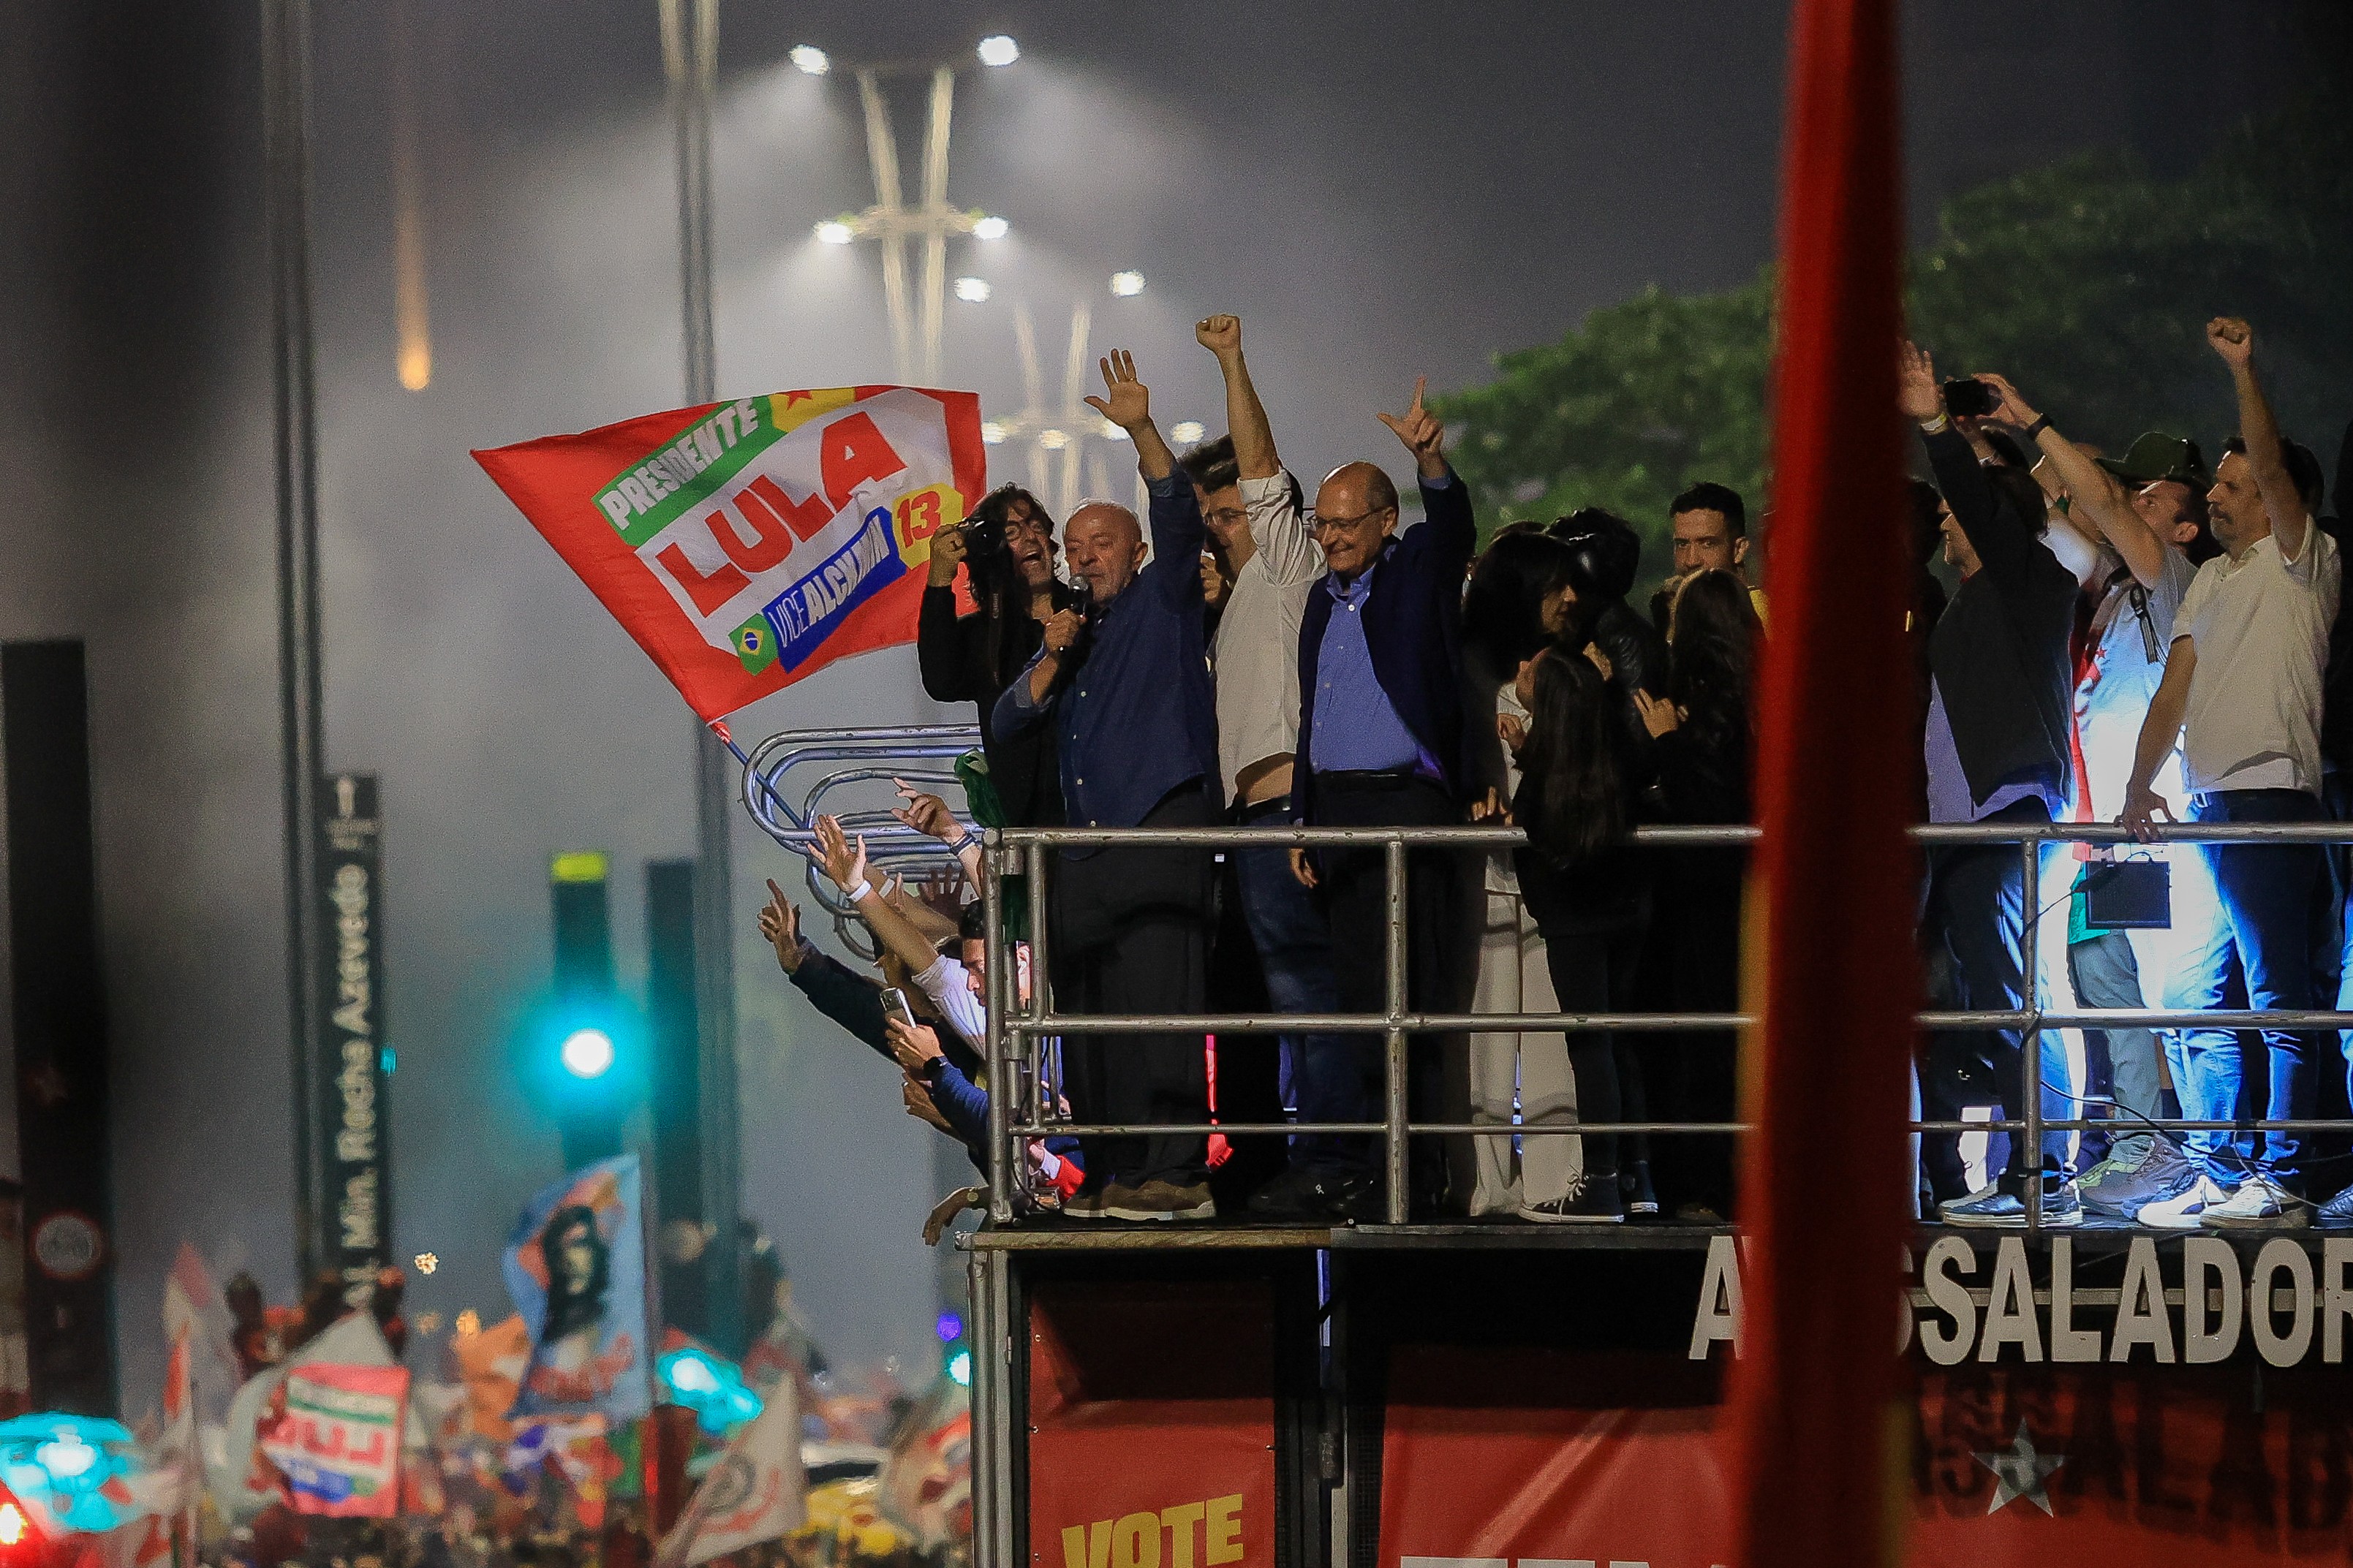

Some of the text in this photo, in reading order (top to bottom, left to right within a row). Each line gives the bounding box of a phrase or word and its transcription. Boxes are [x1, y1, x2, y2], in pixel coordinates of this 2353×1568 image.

[599, 397, 759, 531] PRESIDENTE
[655, 411, 907, 618] LULA
[898, 491, 941, 549] 13
[768, 590, 809, 648] VICE
[330, 863, 373, 1035] Azevedo
[334, 1038, 376, 1163] Rocha
[1062, 1493, 1243, 1568] VOTE
